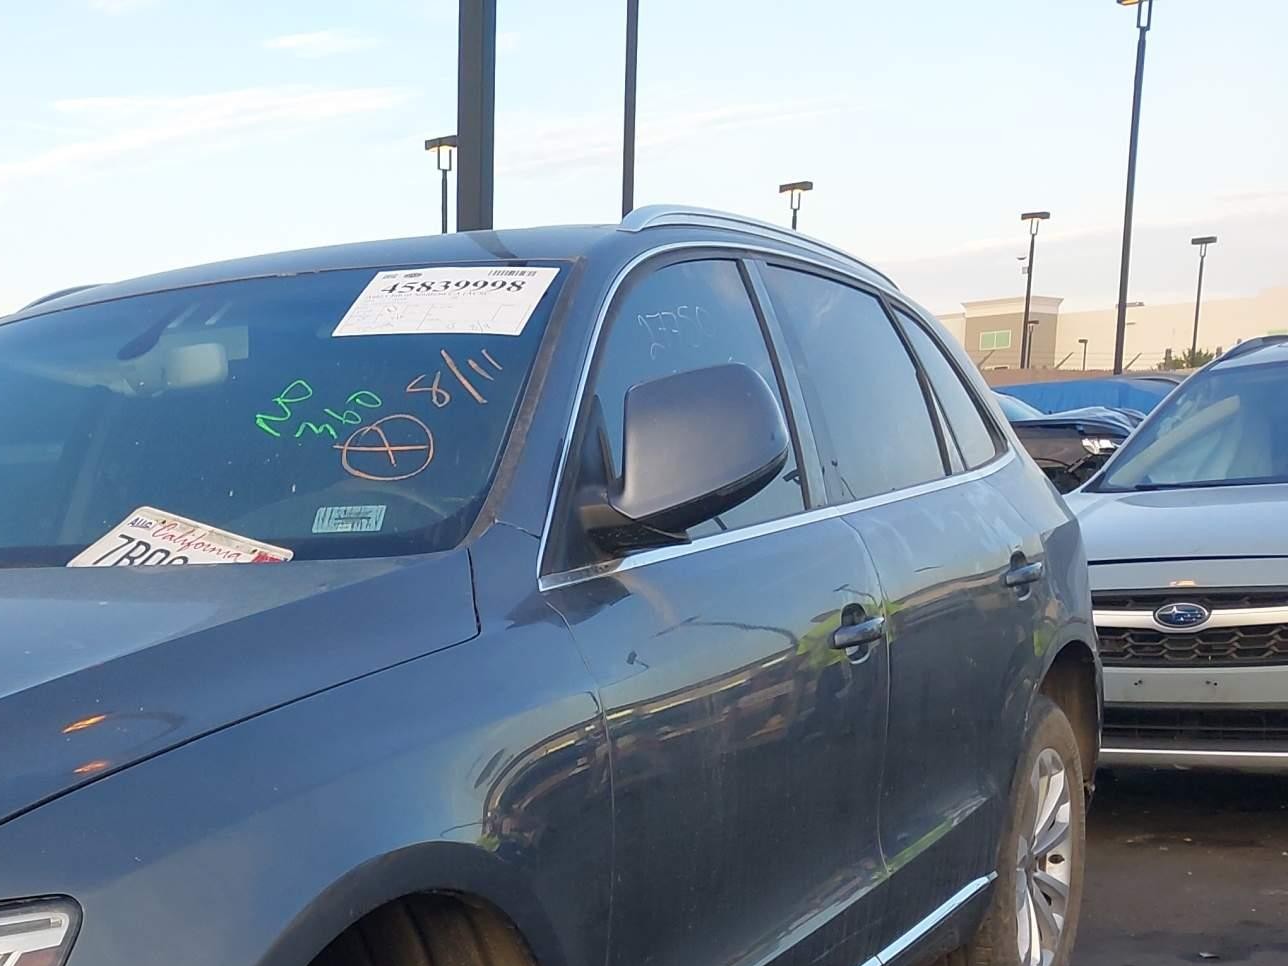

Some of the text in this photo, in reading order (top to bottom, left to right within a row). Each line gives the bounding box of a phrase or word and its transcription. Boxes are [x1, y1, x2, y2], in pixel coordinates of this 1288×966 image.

[381, 279, 526, 295] 45839998
[406, 349, 503, 408] 8/11
[294, 390, 382, 439] 360
